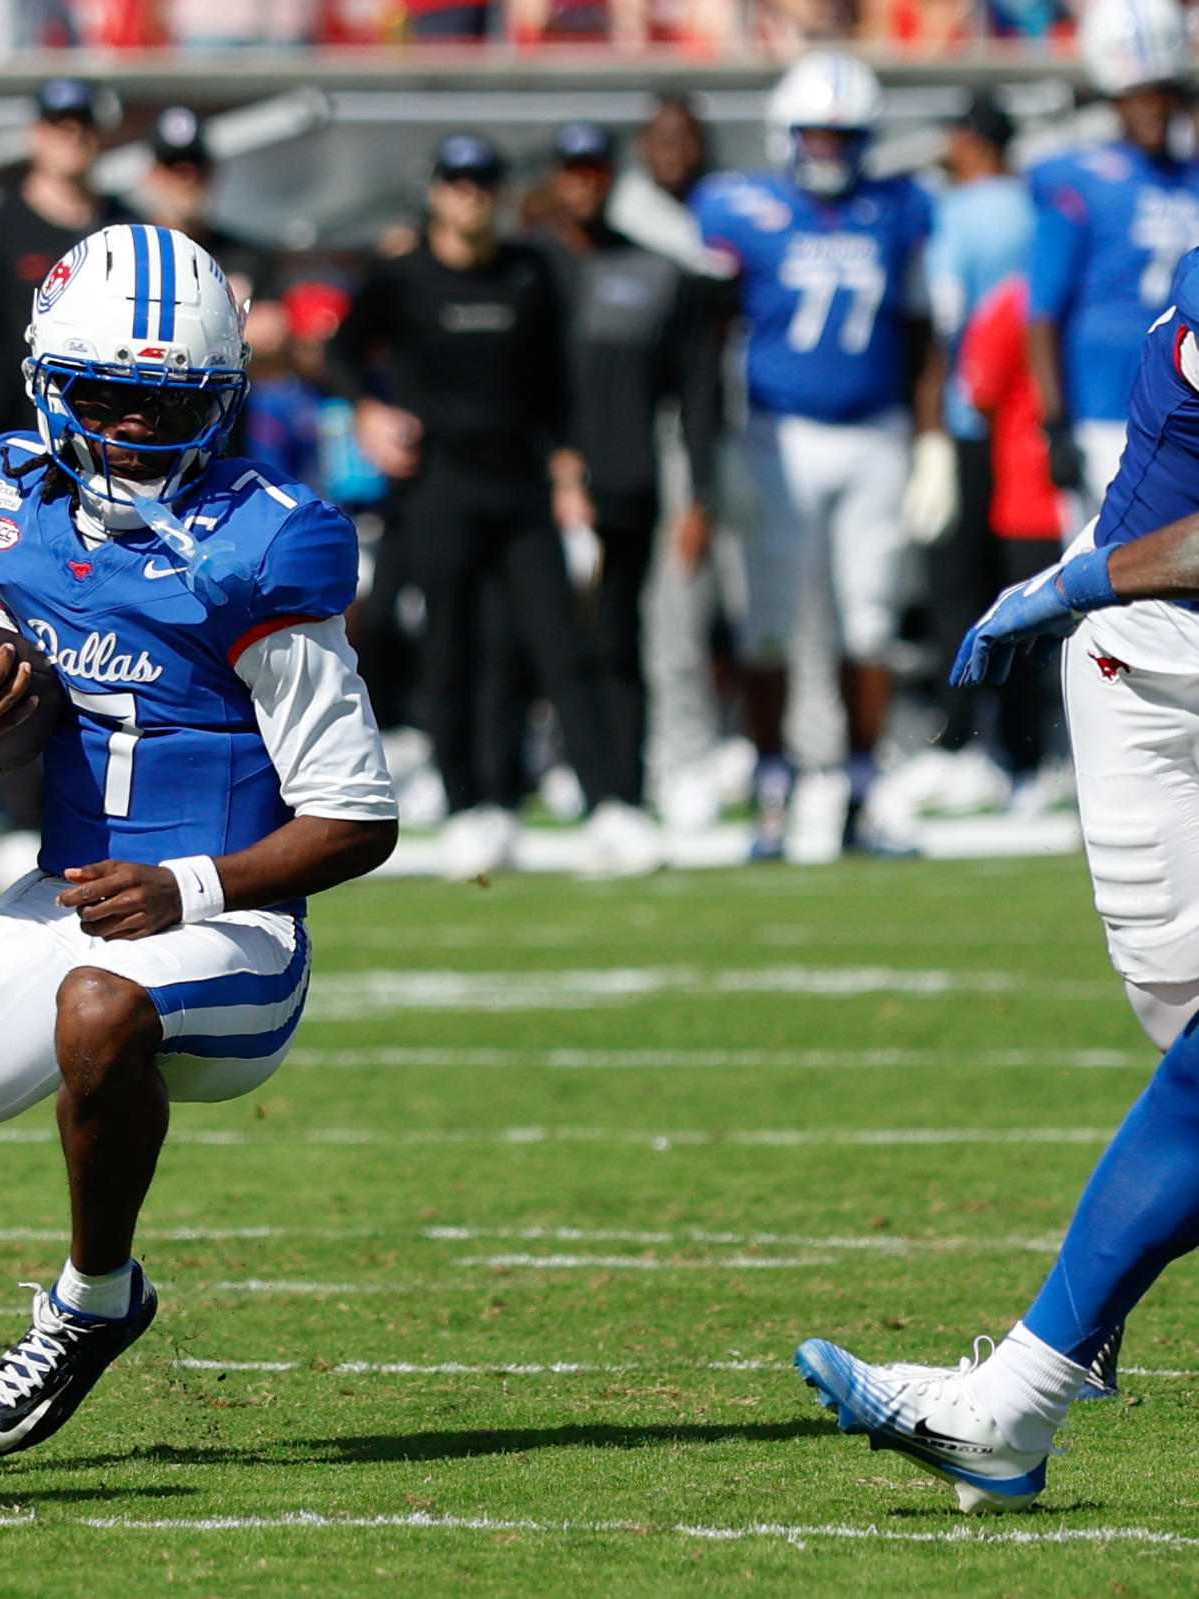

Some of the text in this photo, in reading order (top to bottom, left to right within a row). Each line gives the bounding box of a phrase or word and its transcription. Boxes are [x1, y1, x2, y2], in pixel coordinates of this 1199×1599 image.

[778, 258, 887, 354] 77
[230, 469, 298, 509] 7
[27, 619, 163, 682] Dallas
[68, 692, 145, 818] 7
[958, 1444, 993, 1455] ZOOM
